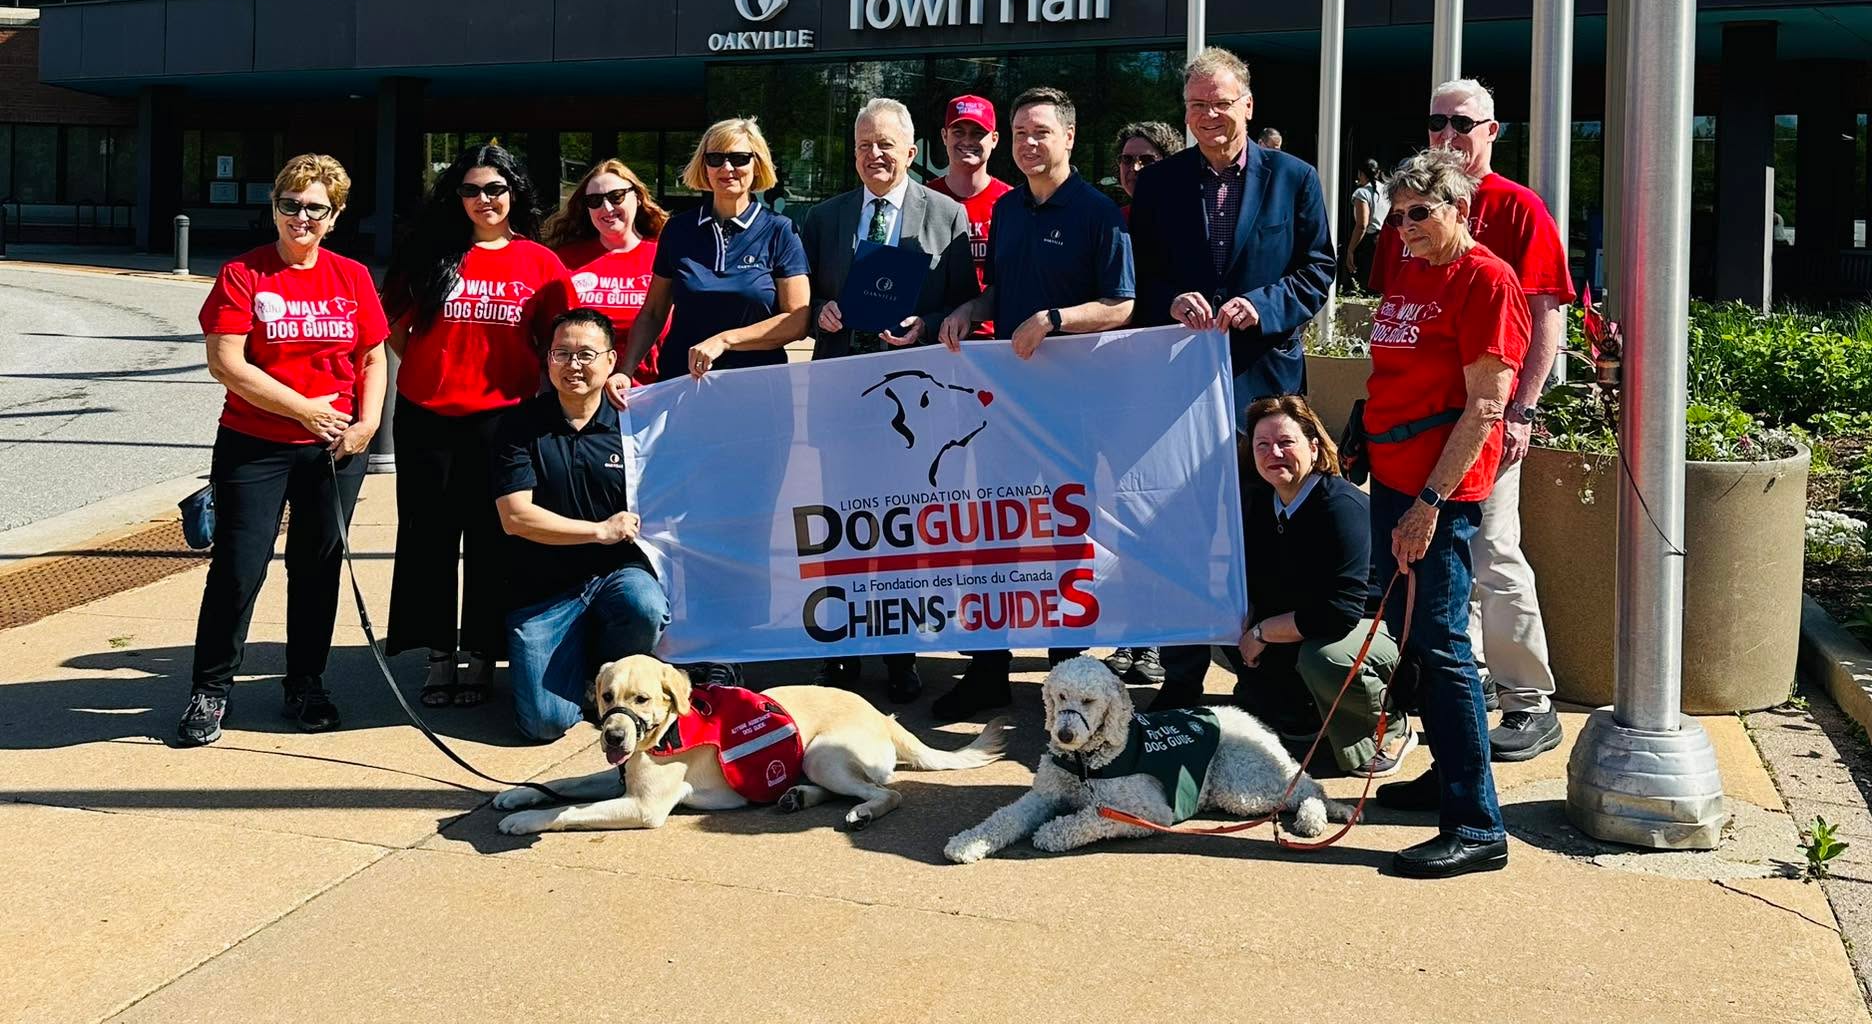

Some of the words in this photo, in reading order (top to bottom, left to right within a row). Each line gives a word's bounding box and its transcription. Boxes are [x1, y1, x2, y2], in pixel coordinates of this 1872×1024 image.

[708, 29, 814, 51] OAKVILLE
[466, 280, 507, 296] WALK
[600, 277, 635, 289] WALK
[607, 292, 645, 305] GUIDE
[286, 301, 330, 316] WALK
[444, 302, 471, 318] DOG
[474, 303, 523, 322] GUIDES
[1396, 303, 1425, 321] WALK
[266, 321, 299, 339] DOG
[302, 321, 354, 339] GUIDES
[840, 496, 879, 511] LIONS
[885, 489, 970, 508] FOUNDATION
[977, 487, 993, 500] OF
[996, 484, 1051, 498] CANADA
[853, 581, 866, 592] La
[870, 578, 929, 592] Fondation
[932, 576, 952, 587] des
[956, 573, 987, 586] Lions
[991, 572, 1006, 584] du
[1009, 570, 1053, 583] Canada
[1144, 741, 1167, 753] DOG
[1167, 734, 1195, 747] GUIDE
